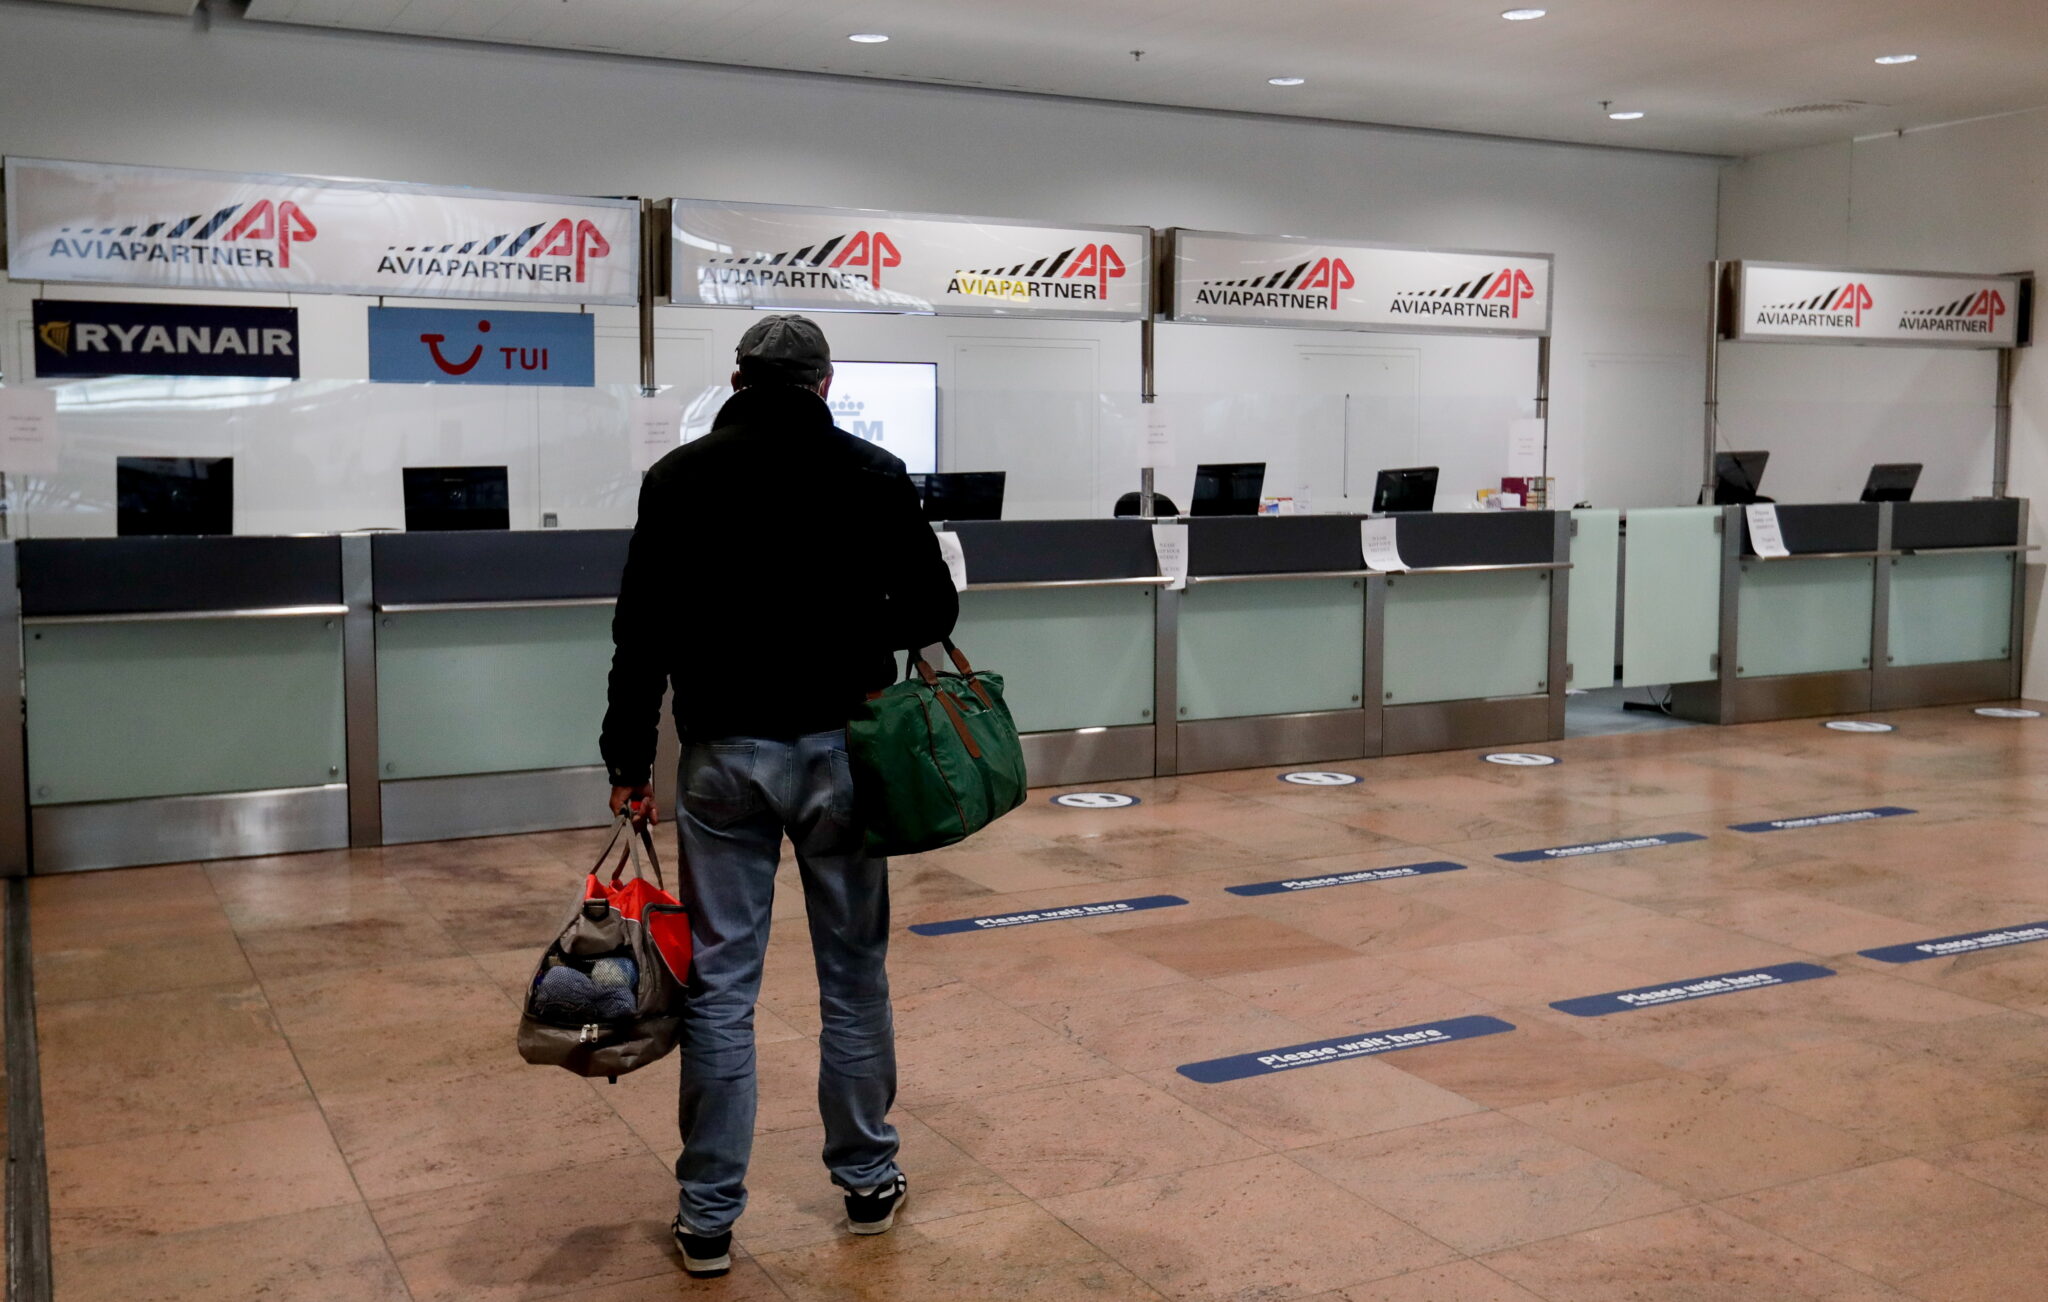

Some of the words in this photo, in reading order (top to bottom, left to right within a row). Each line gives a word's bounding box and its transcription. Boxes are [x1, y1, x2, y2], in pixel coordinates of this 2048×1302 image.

[49, 237, 274, 269] AVIAPARTNER
[377, 255, 572, 283] AVIAPARTNER
[947, 277, 1097, 300] AVIAPARTNER
[1196, 288, 1329, 310] AVIAPARTNER
[1390, 299, 1510, 319] AVIAPARTNER
[1757, 311, 1854, 328] AVIAPARTNER
[1898, 317, 1988, 333] AVIAPARTNER
[75, 322, 294, 356] RYANAIR
[499, 346, 548, 371] TUI
[974, 912, 1040, 927] Please
[1041, 907, 1084, 918] wait
[1083, 902, 1129, 913] here
[1617, 988, 1687, 1004] Please
[1683, 980, 1730, 993] wait
[1721, 973, 1773, 986] here
[1257, 1045, 1339, 1066] Please
[1336, 1037, 1391, 1051] wait
[1385, 1029, 1443, 1043] here
